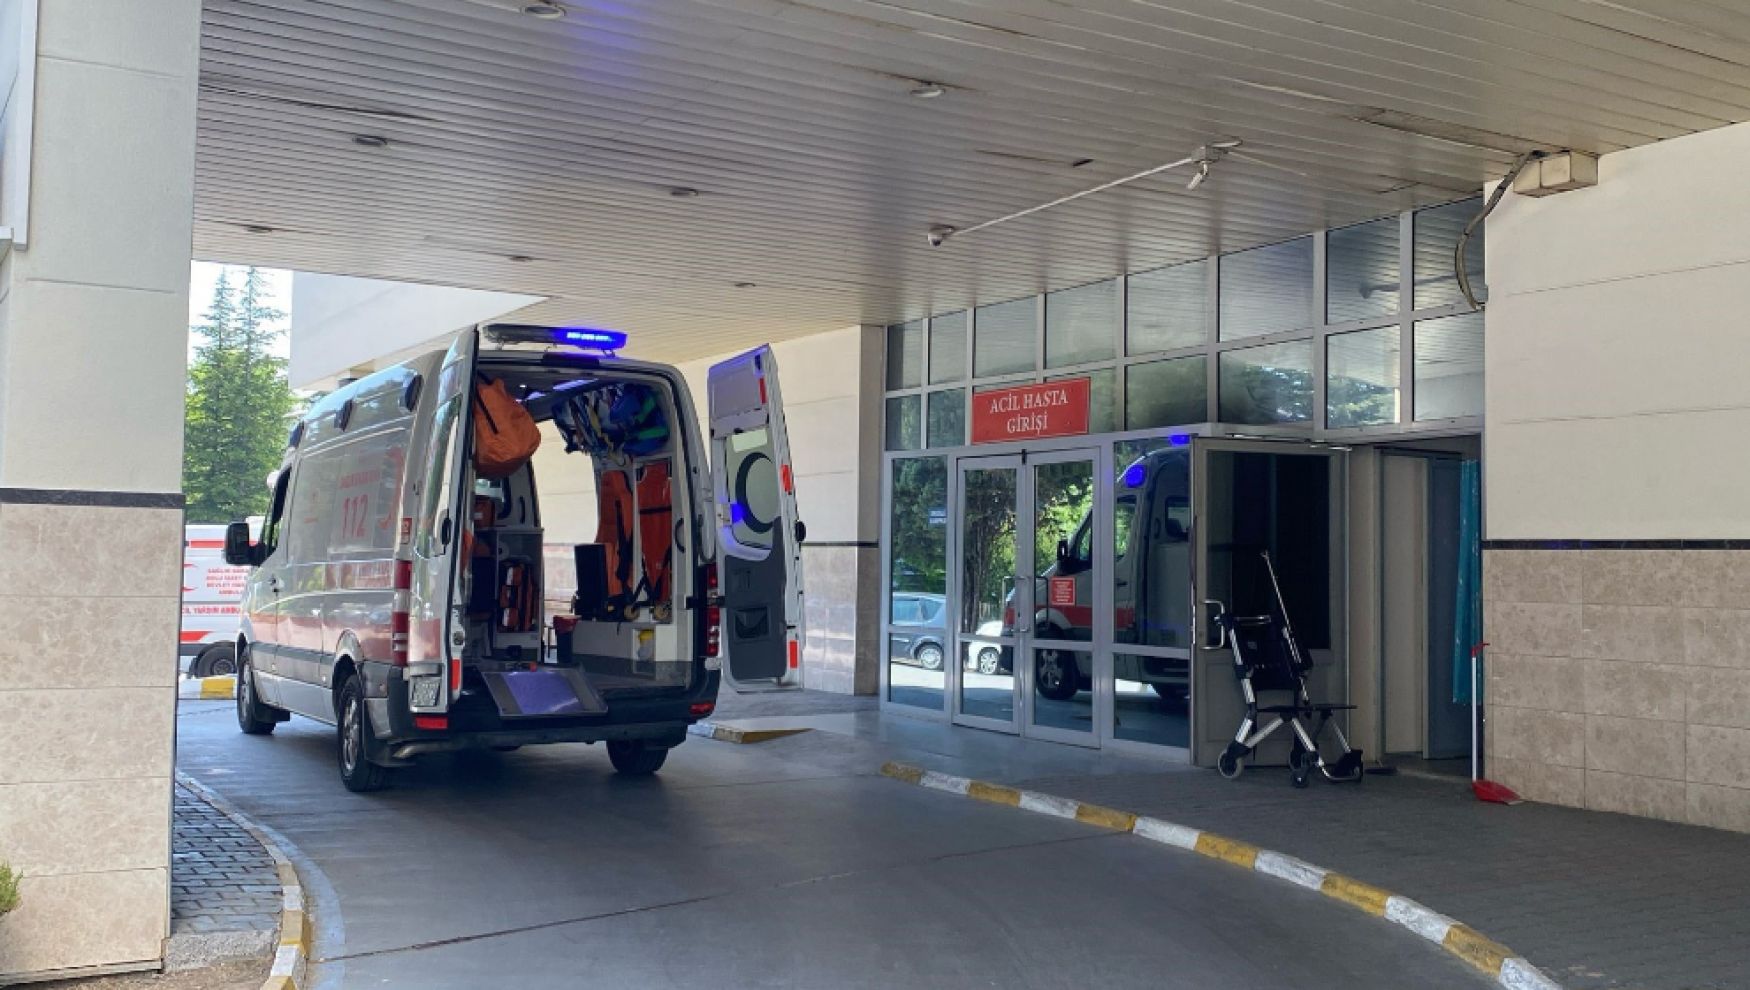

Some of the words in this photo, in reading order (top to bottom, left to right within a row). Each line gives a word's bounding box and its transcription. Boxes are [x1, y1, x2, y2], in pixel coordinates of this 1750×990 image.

[990, 393, 1020, 413] ACİL
[1023, 389, 1068, 409] HASTA
[1007, 411, 1049, 436] GİRİŞİ
[342, 494, 369, 539] 112
